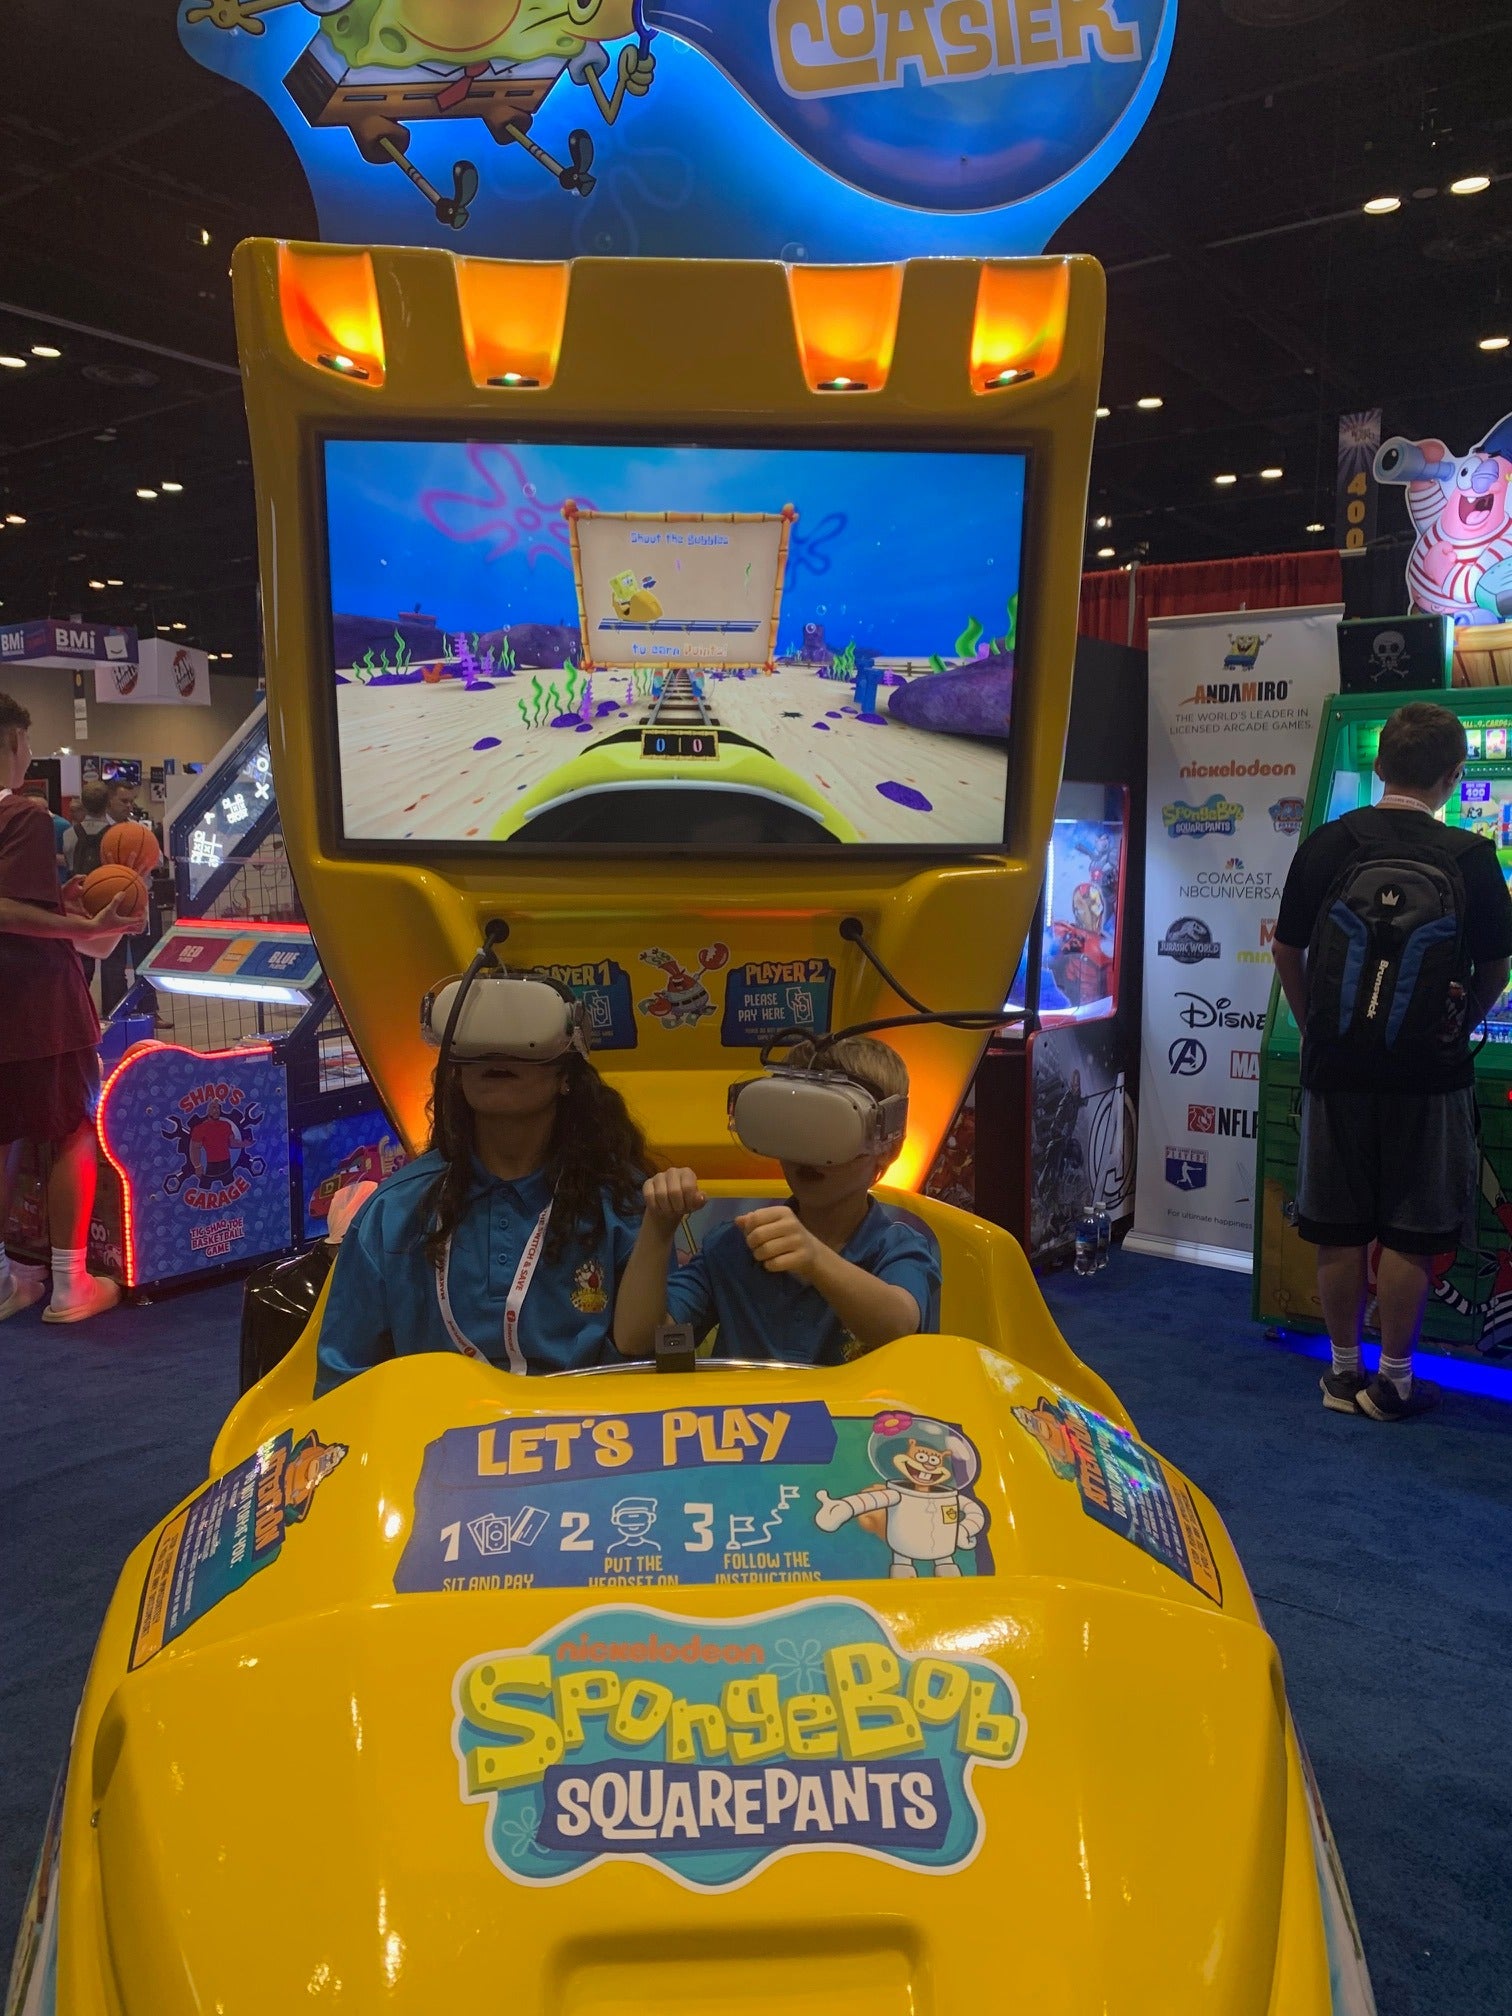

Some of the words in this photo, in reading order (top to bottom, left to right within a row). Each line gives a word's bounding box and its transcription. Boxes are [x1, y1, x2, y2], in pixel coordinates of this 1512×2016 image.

[1191, 680, 1289, 704] ANDAMIRO
[1176, 714, 1195, 723] THE
[1197, 710, 1247, 722] WORLD'S
[1250, 708, 1295, 720] LEADER
[1297, 708, 1309, 718] IN
[1169, 723, 1221, 736] LICENSED
[1223, 721, 1269, 733] ARCADE
[1180, 758, 1297, 778] nickelodeon
[1465, 788, 1486, 797] 400
[1175, 821, 1231, 833] SQUAREPANTS
[1197, 872, 1273, 886] COMCAST
[1179, 886, 1283, 900] NBCUNIVERSA
[178, 945, 205, 957] RED
[268, 951, 300, 965] BLUE
[745, 961, 808, 985] PLAYER
[808, 959, 827, 983] 2
[1366, 959, 1389, 1020] Brunswick
[744, 992, 778, 1008] PLEASE
[738, 1009, 760, 1023] PAY
[762, 1007, 786, 1022] HERE
[178, 1083, 246, 1114] SHAQ'S
[183, 1176, 251, 1210] GARAGE
[205, 1219, 227, 1235] SHAQ
[1167, 1208, 1180, 1217] For
[1181, 1212, 1213, 1223] ultimate
[1213, 1216, 1253, 1230] happiness
[191, 1229, 245, 1249] BASKETBALL
[526, 1225, 546, 1260] SWITCH
[206, 1242, 230, 1257] GAME
[522, 1259, 532, 1269] &
[515, 1270, 529, 1292] SAVE
[476, 1418, 634, 1477] LET'S
[662, 1407, 792, 1467] PLAY
[439, 1520, 462, 1562] 1
[560, 1512, 594, 1552] 2
[684, 1502, 714, 1552] 3
[604, 1556, 633, 1574] PUT
[637, 1554, 664, 1573] THE
[723, 1553, 781, 1571] FOLLOW
[783, 1551, 811, 1569] THE
[443, 1576, 466, 1592] SIT
[468, 1575, 500, 1591] AND
[503, 1573, 535, 1590] PAY
[556, 1634, 765, 1665] nickelodeon
[467, 1642, 1021, 1797] SpongeBob
[555, 1767, 938, 1840] SQUAREPANTS
